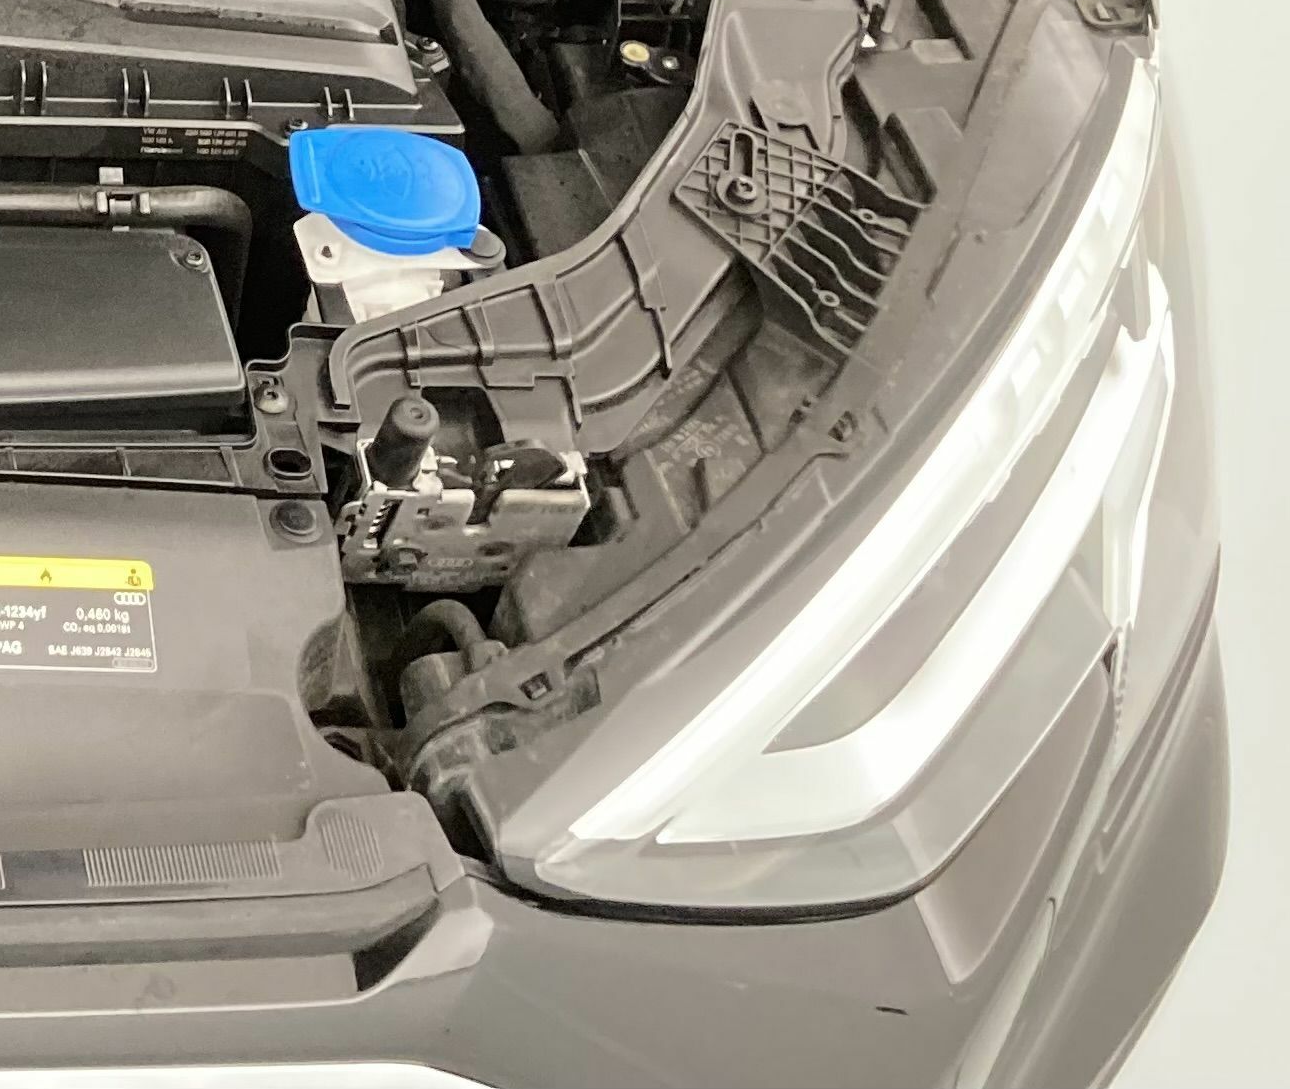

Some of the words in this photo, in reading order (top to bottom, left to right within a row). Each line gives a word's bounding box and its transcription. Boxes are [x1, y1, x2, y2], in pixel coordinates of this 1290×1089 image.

[114, 608, 130, 623] kg
[17, 621, 25, 630] 4
[83, 624, 96, 634] eq
[48, 644, 68, 656] SAE
[70, 646, 93, 656] J639
